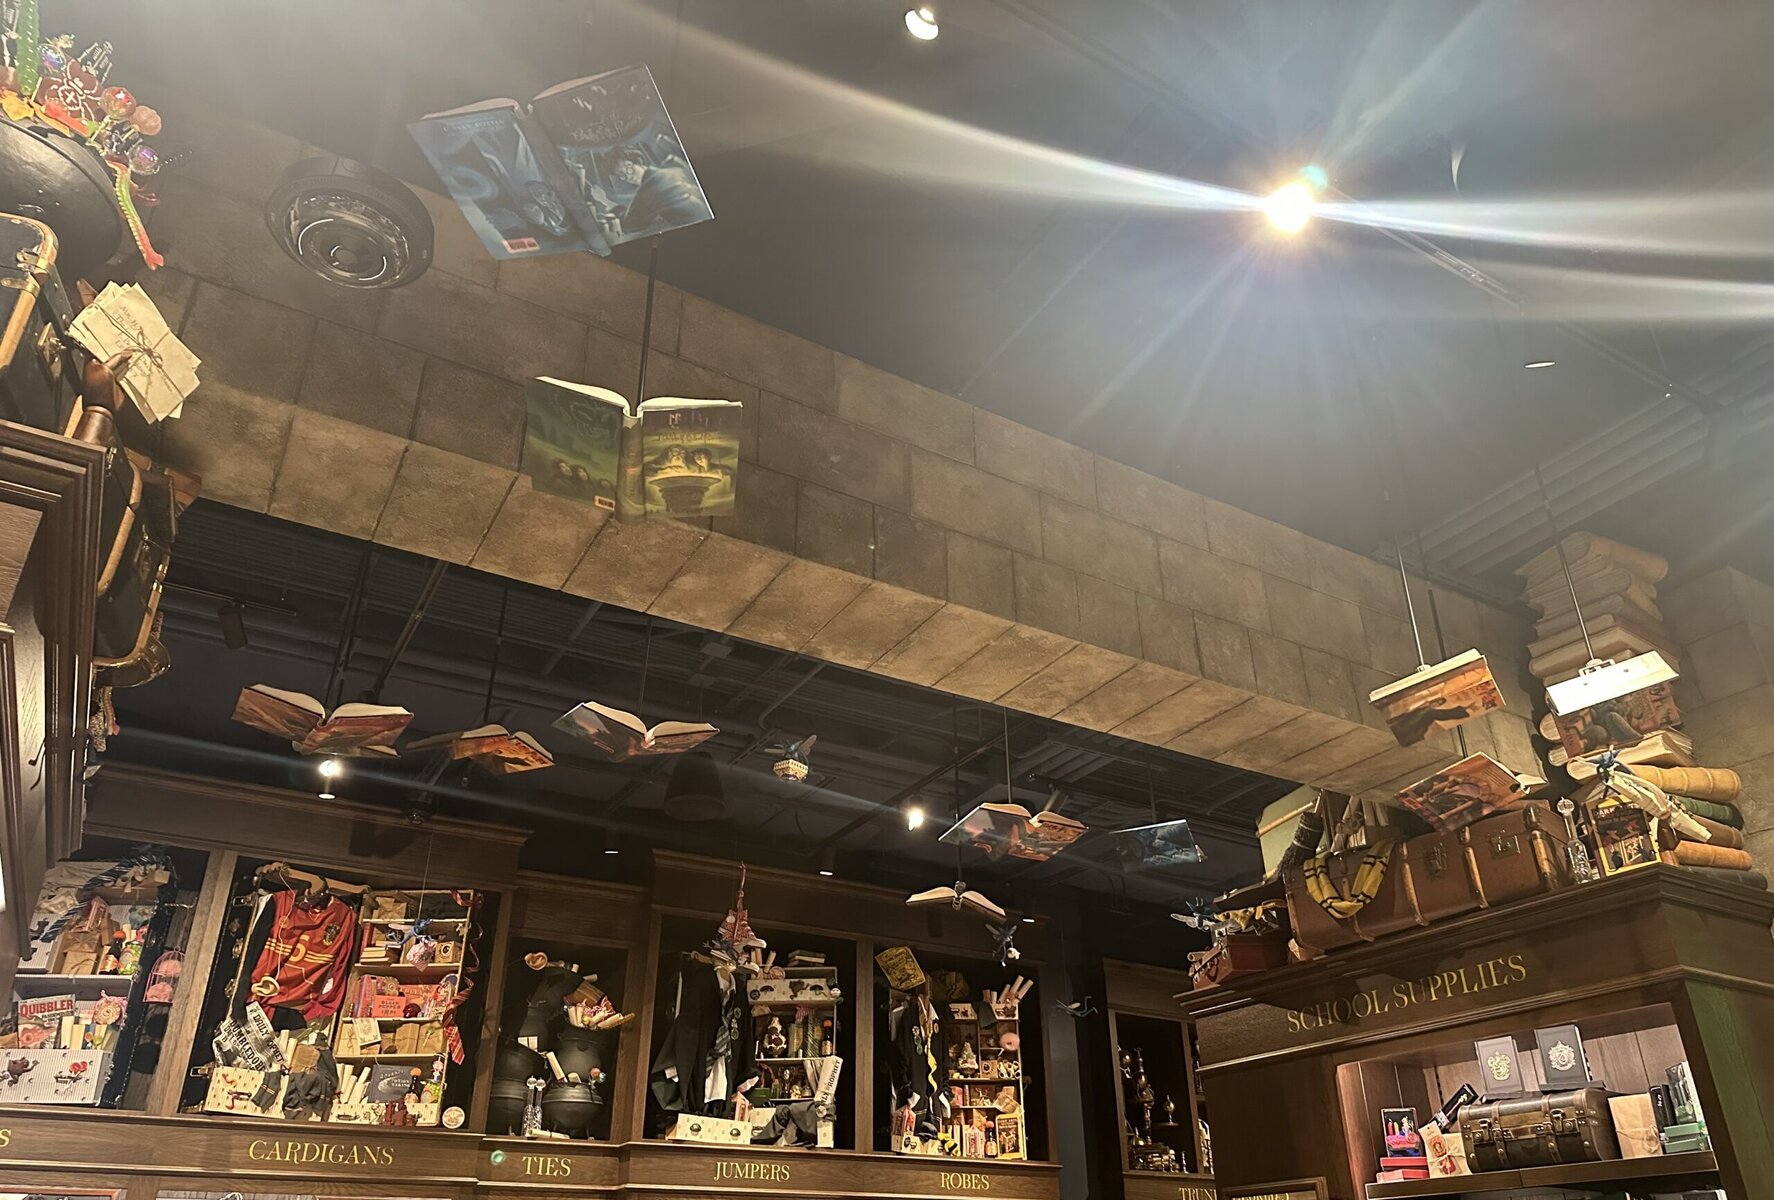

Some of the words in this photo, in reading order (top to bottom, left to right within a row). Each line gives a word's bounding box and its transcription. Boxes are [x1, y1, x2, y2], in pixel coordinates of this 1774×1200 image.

[1287, 990, 1389, 1033] SCHOOL
[1392, 955, 1527, 1009] SUPPLIES
[20, 999, 74, 1017] QUIBBLER
[252, 1014, 270, 1037] DAILY
[248, 1139, 394, 1166] CARDIGANS
[521, 1155, 572, 1177] TIES
[713, 1161, 790, 1182] JUMPERS
[940, 1172, 990, 1190] ROBES
